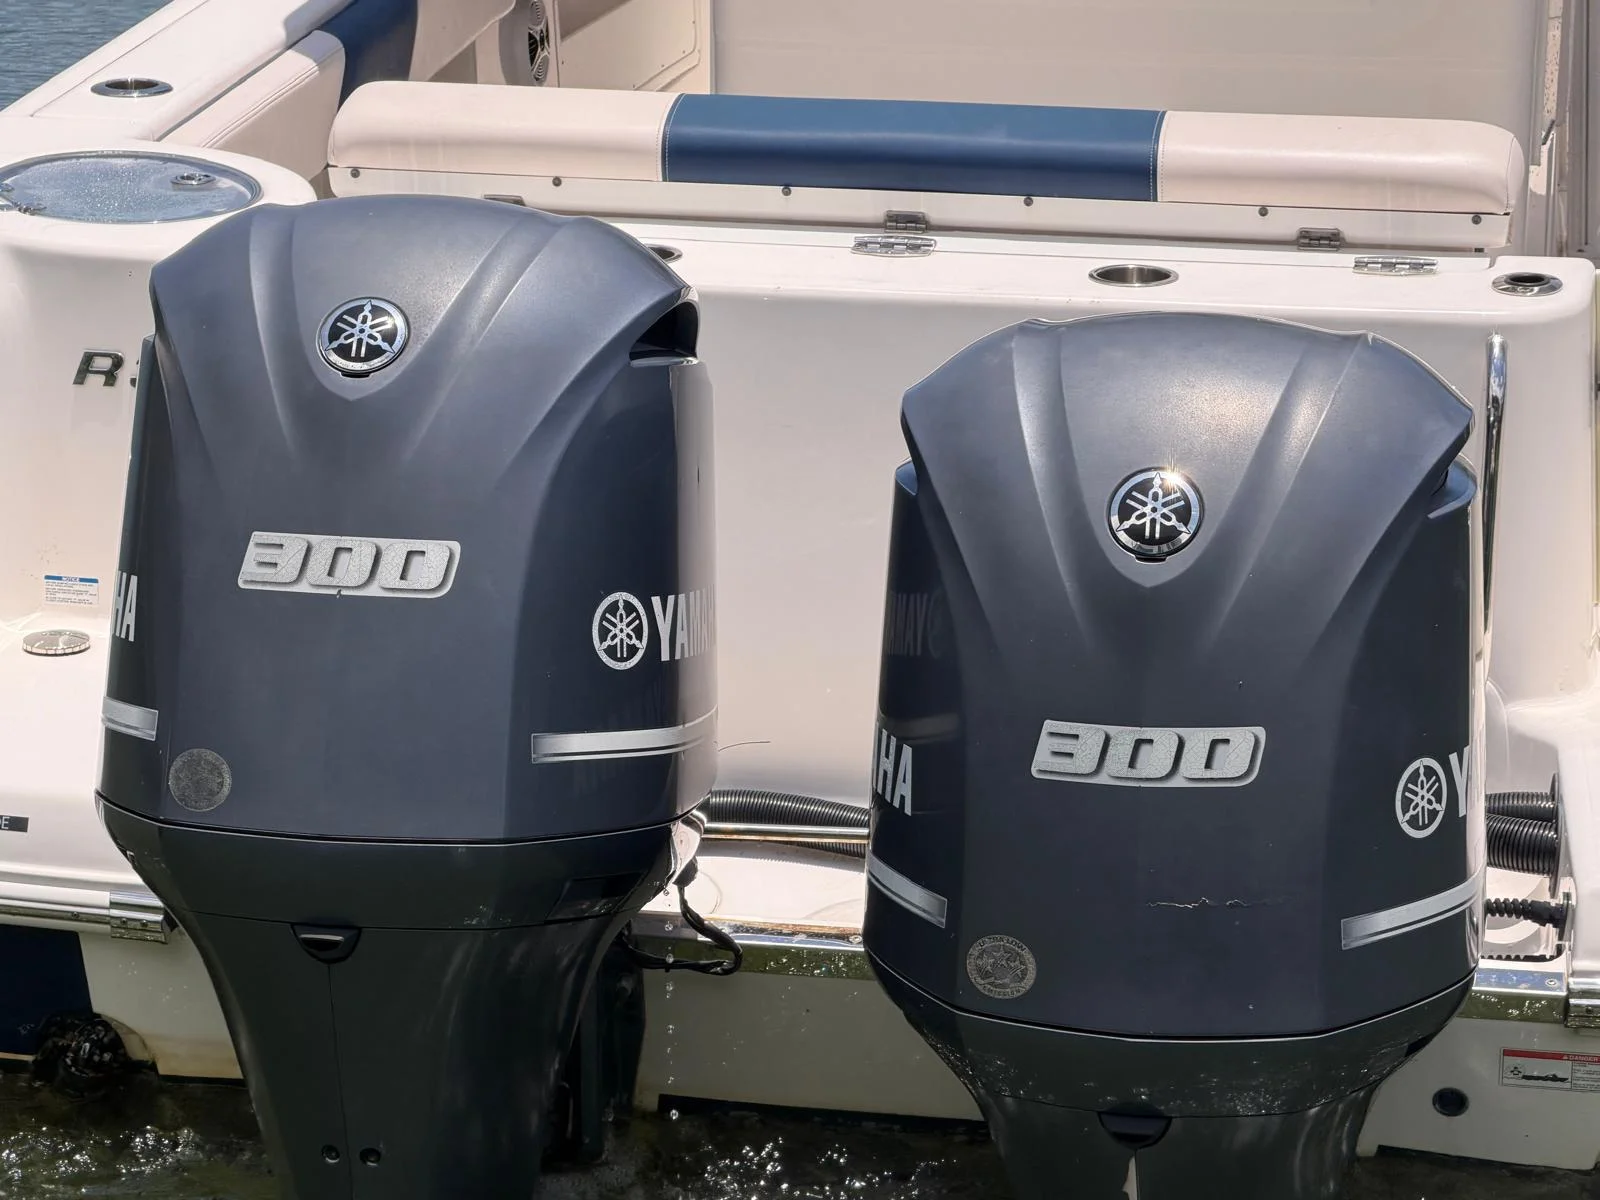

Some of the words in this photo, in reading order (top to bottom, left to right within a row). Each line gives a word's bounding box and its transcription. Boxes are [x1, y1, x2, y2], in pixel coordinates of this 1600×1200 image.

[72, 349, 138, 388] R
[239, 532, 456, 592] 300
[1034, 721, 1259, 781] 300
